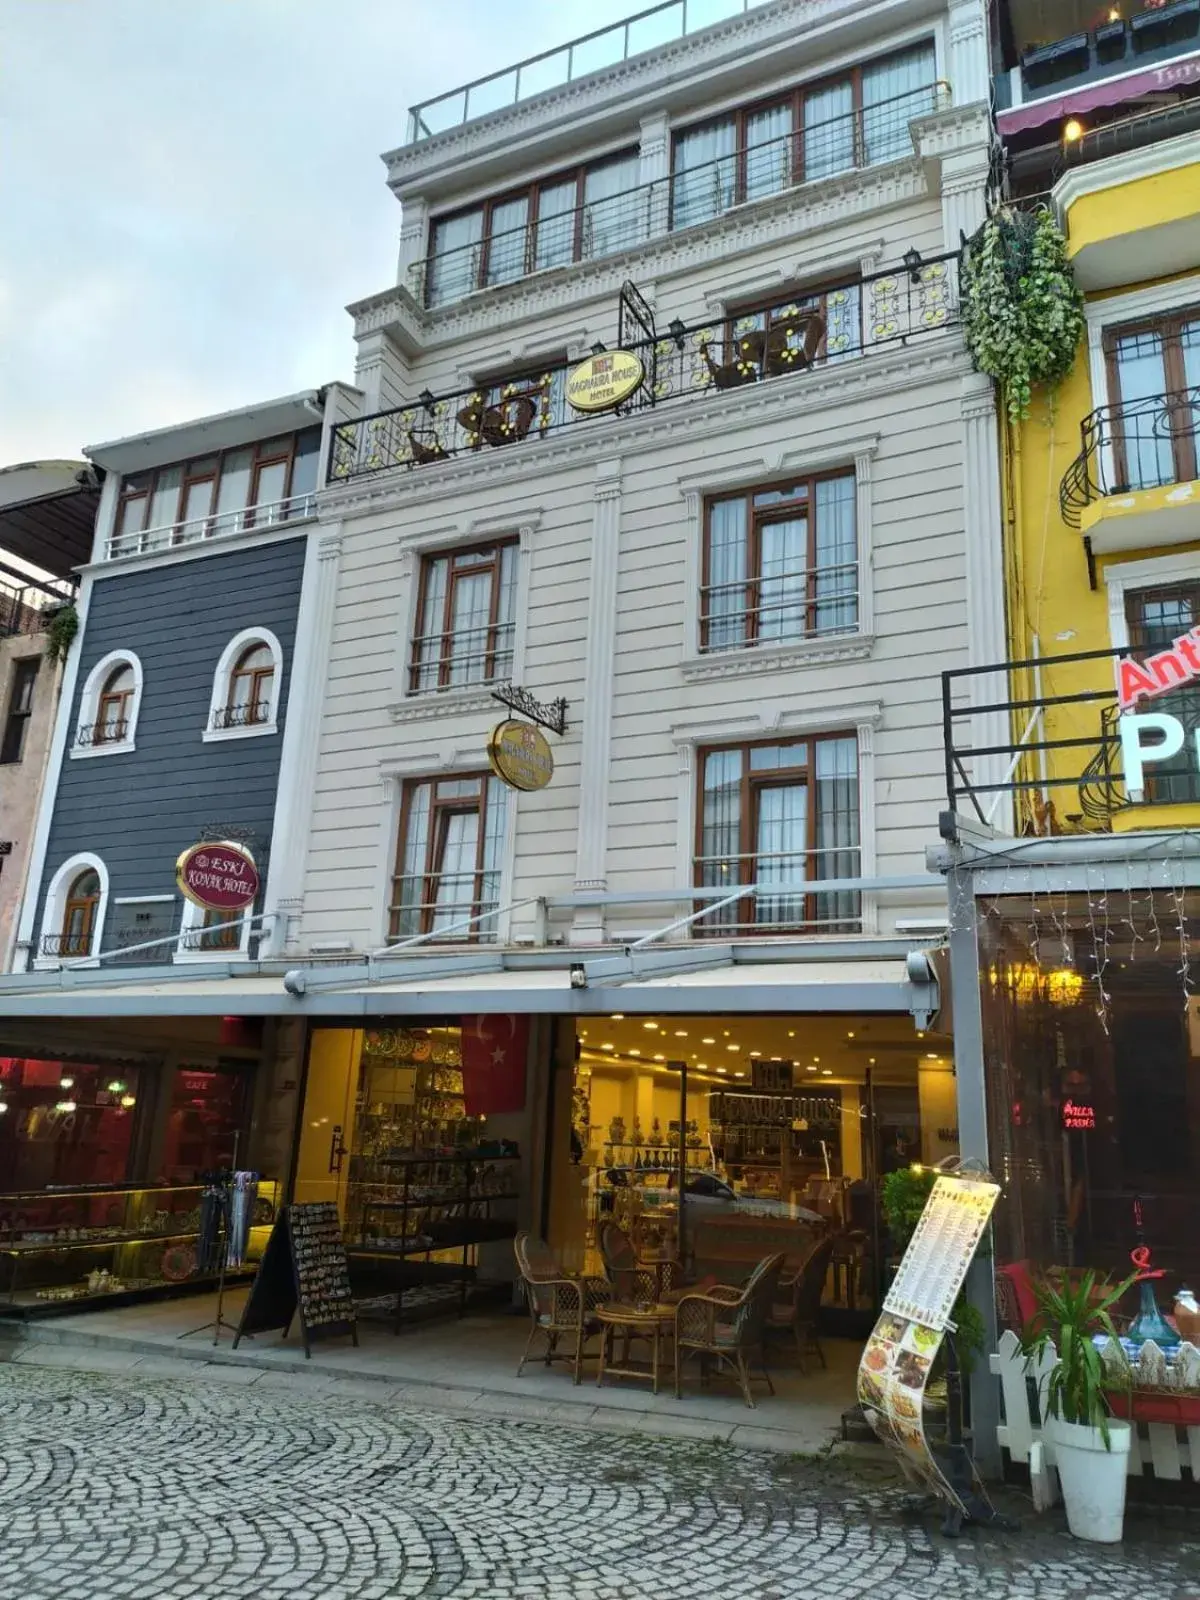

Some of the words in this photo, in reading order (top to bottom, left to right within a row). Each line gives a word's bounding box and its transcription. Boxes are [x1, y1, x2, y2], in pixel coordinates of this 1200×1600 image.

[1120, 629, 1200, 703] Ant
[1120, 712, 1200, 791] P
[188, 869, 222, 892] KONAK
[222, 878, 253, 896] HOTEL
